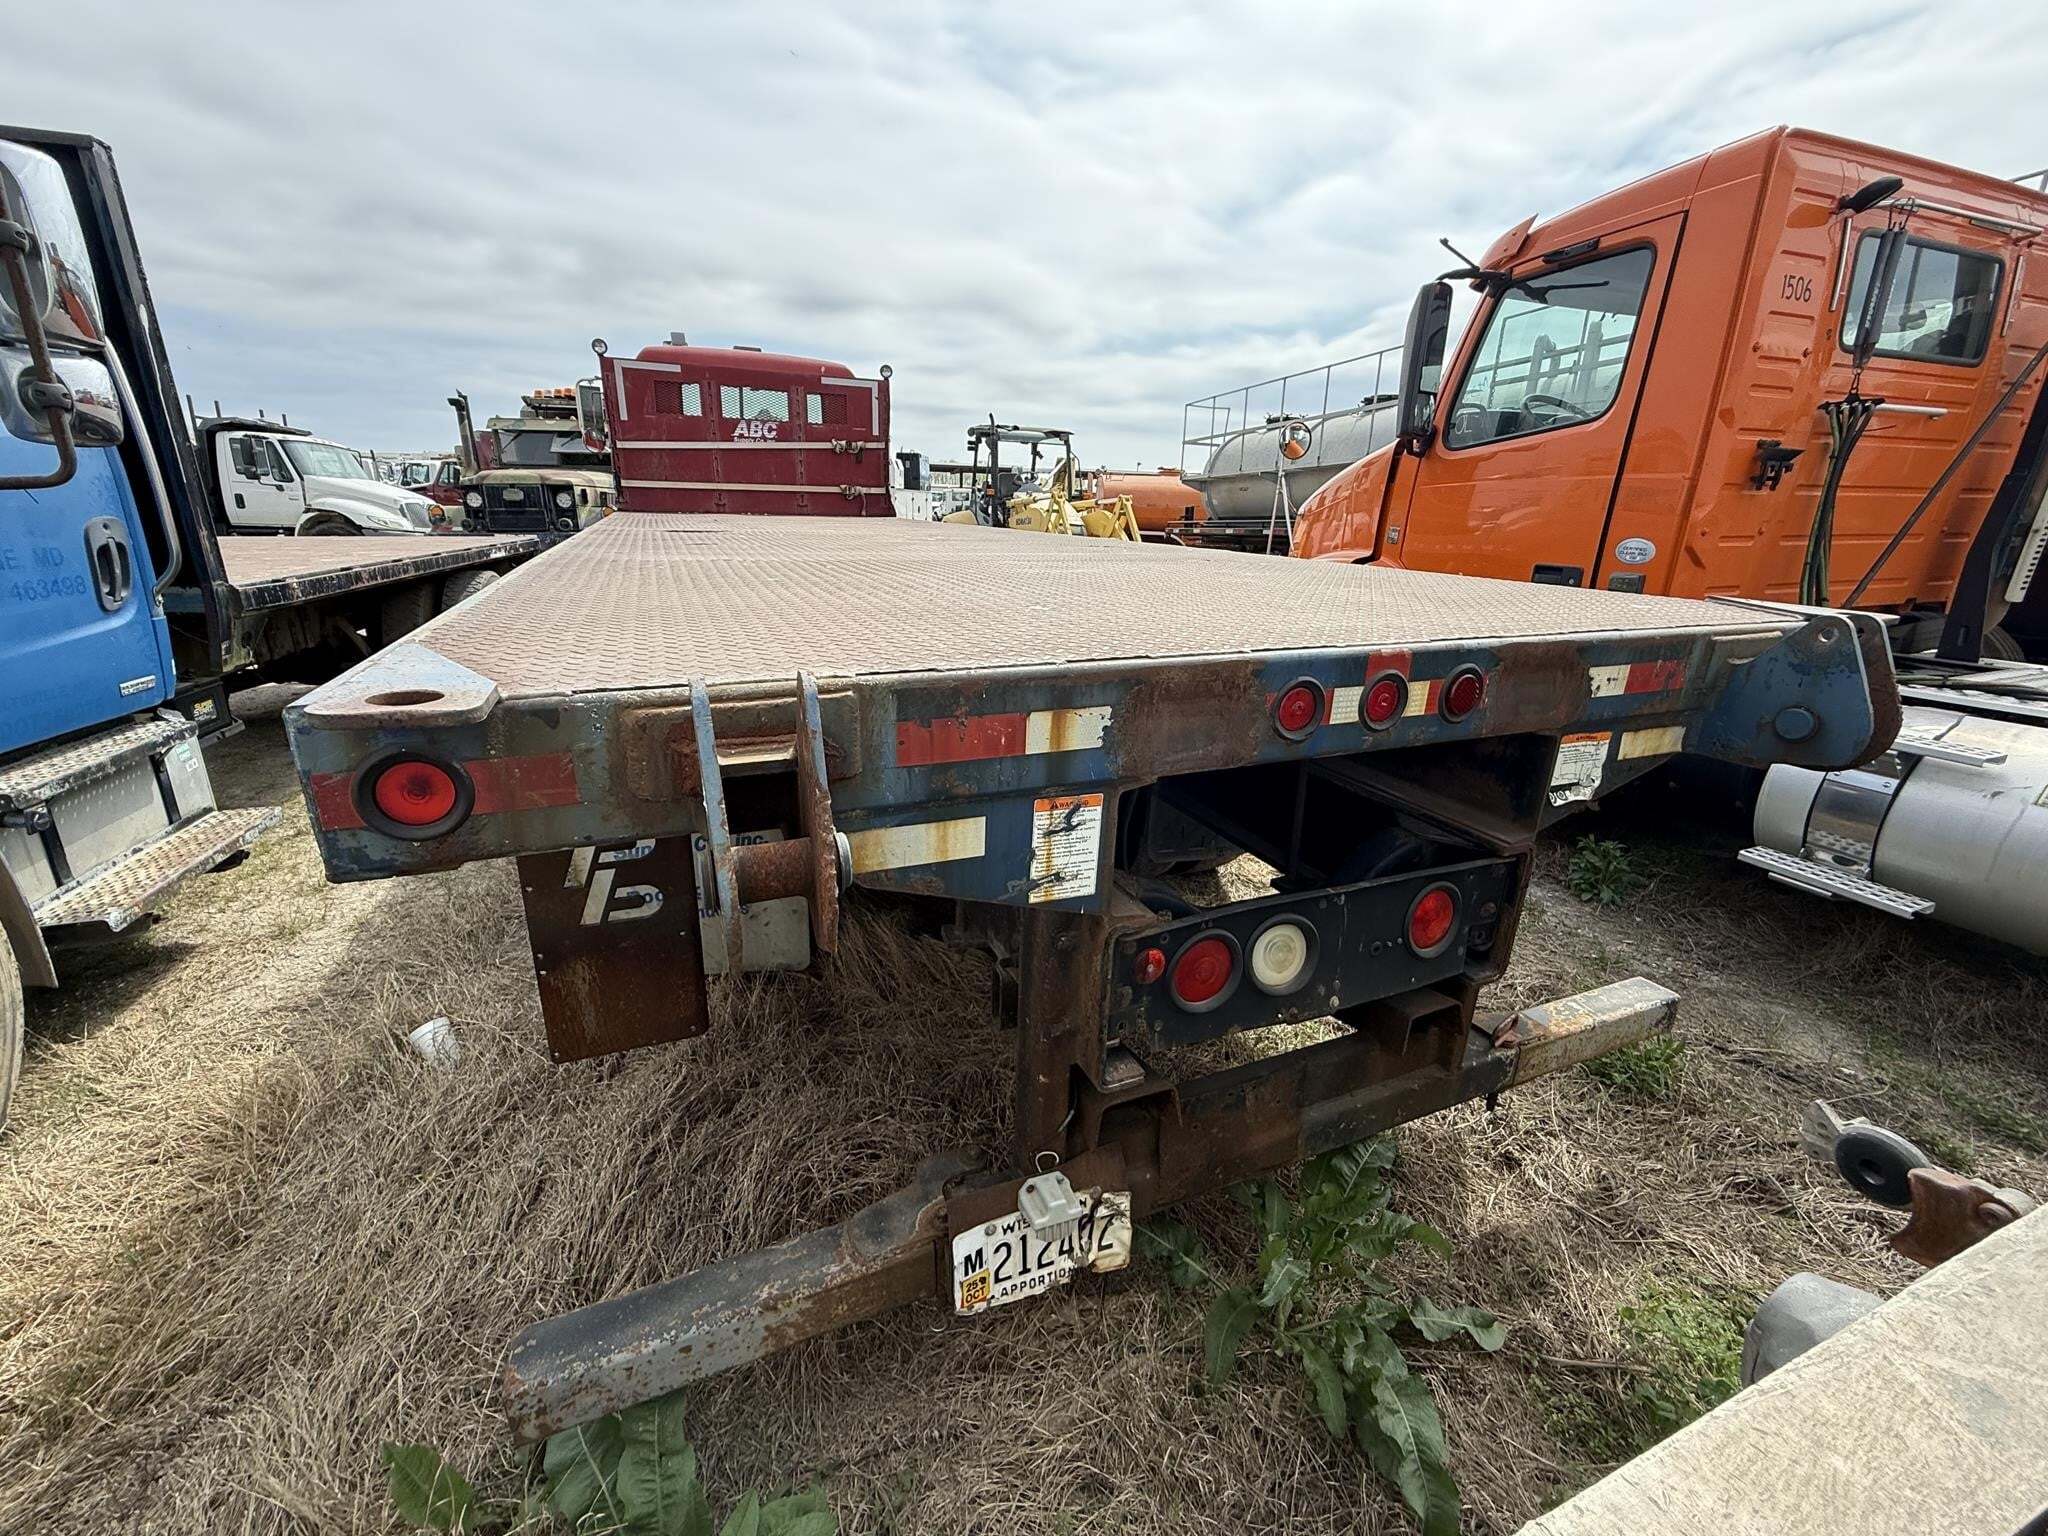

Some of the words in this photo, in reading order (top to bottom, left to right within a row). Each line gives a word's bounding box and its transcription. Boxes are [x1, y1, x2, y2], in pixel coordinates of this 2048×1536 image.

[1780, 273, 1812, 303] 1506
[731, 419, 778, 438] ABC
[0, 548, 21, 570] E
[963, 1246, 984, 1278] M
[965, 1285, 986, 1304] OCT
